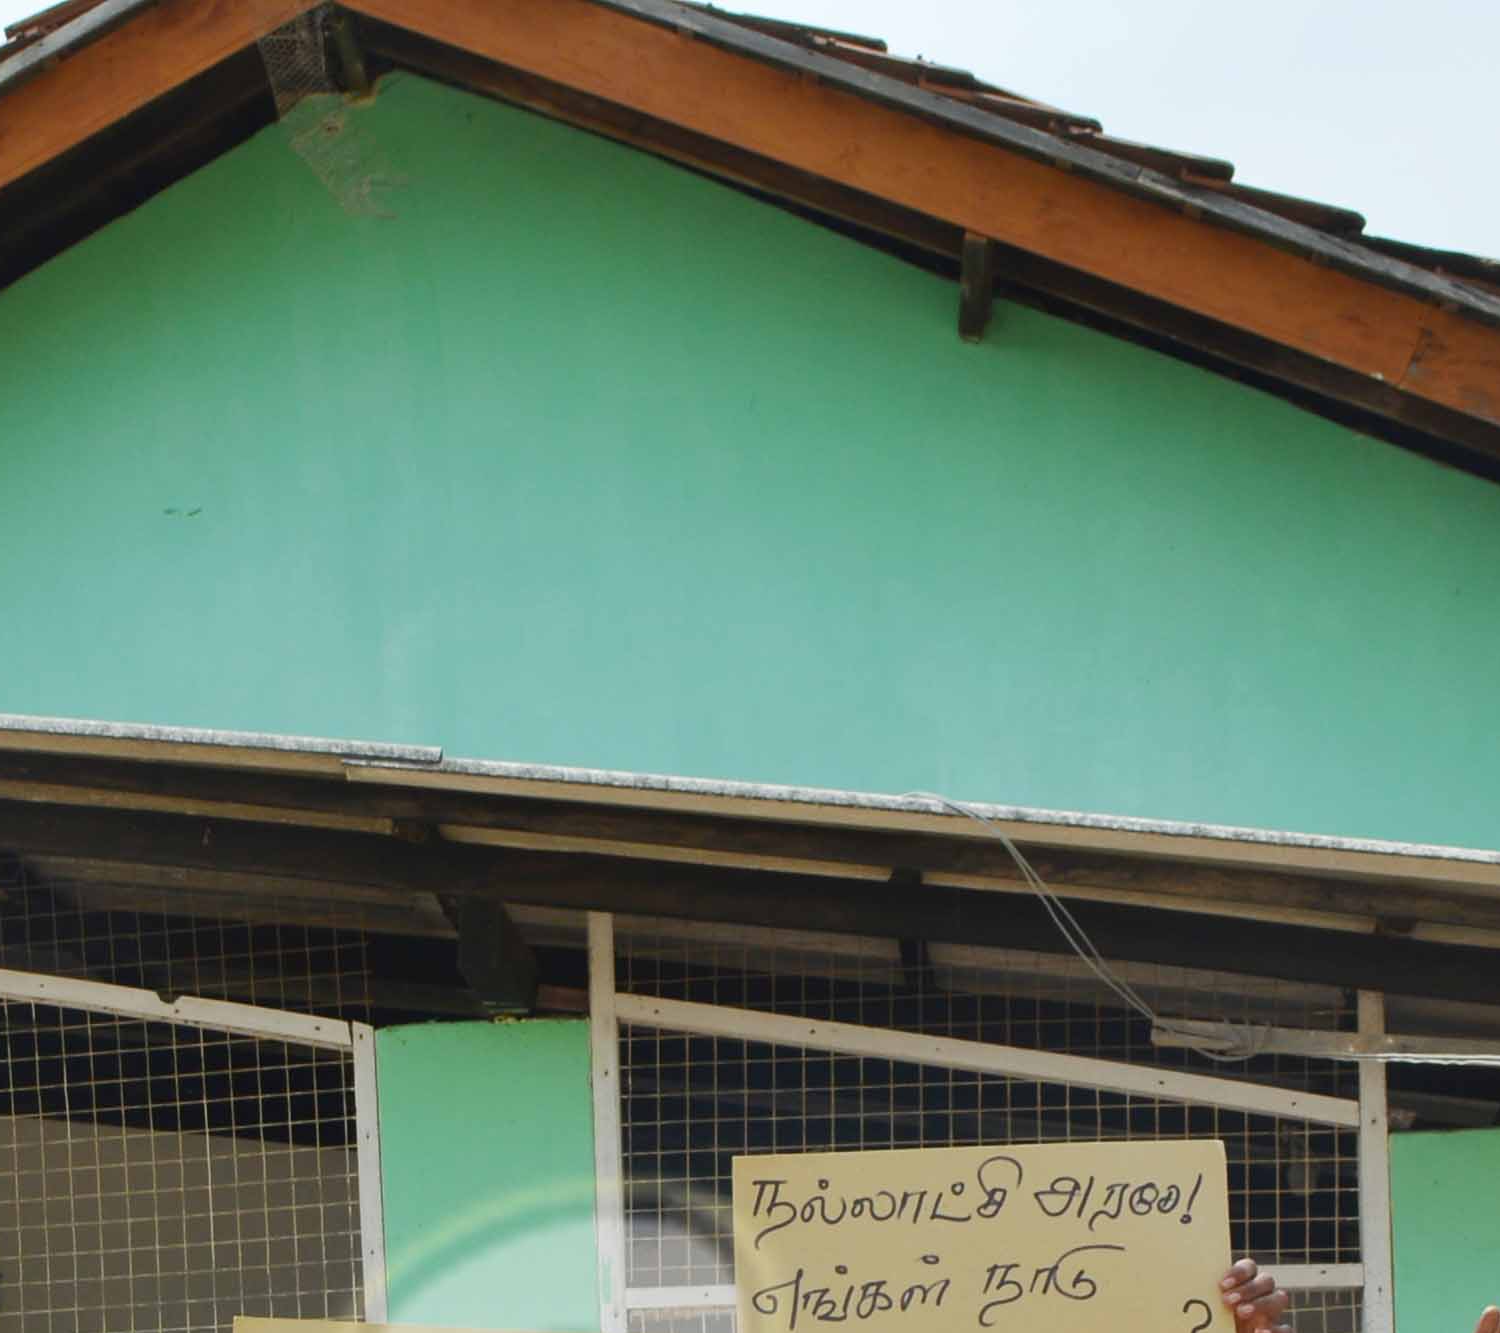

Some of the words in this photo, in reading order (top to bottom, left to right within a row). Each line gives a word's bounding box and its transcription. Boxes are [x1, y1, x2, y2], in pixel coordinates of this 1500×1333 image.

[751, 1155, 1023, 1251] நல்லாட்சி
[1033, 1172, 1204, 1232] அரசே!
[751, 1254, 951, 1331] எங்கள்
[978, 1243, 1126, 1328] நாடு
